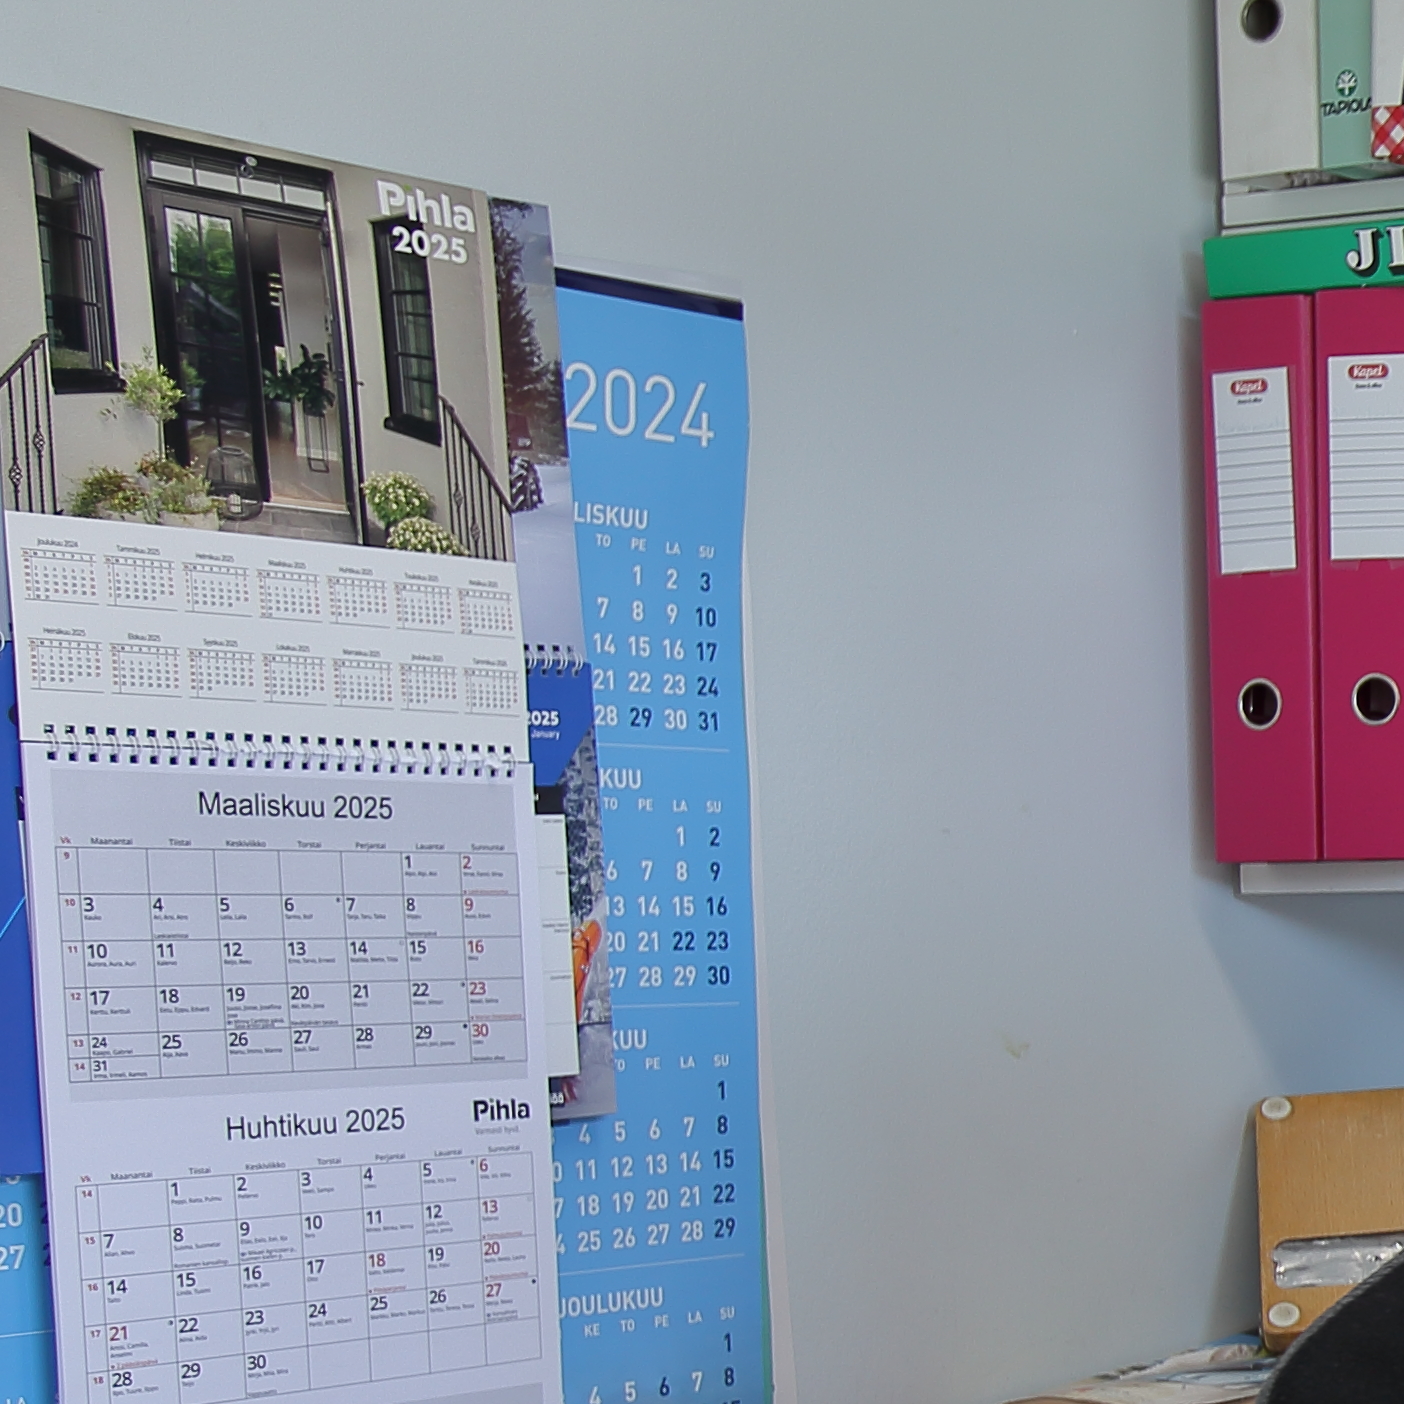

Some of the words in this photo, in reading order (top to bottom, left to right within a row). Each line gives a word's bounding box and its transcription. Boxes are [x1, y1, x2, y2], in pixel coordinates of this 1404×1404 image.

[377, 180, 476, 234] Pihla
[391, 226, 469, 264] 2025
[1352, 364, 1384, 378] Kapel
[565, 361, 715, 448] 2024
[574, 501, 649, 530] LISKUU
[596, 534, 612, 548] TO
[631, 538, 647, 552] PE
[665, 542, 681, 555] LA
[699, 545, 715, 559] SU
[633, 565, 642, 586] 1
[665, 568, 679, 590] 2
[699, 572, 712, 592] 3
[597, 597, 609, 619] 7
[631, 600, 645, 622] 8
[665, 603, 678, 625] 9
[695, 607, 717, 628] 10
[527, 710, 560, 726] 025
[594, 705, 618, 726] 28
[629, 707, 652, 729] 29
[663, 709, 687, 731] 30
[698, 711, 720, 732] 31
[601, 768, 643, 790] KUU
[198, 790, 326, 820] Maaliskuu
[333, 794, 394, 821] 2025
[87, 944, 108, 960] 10
[156, 943, 175, 958] 11
[223, 942, 243, 957] 12
[288, 941, 306, 956] 13
[349, 940, 368, 955] 14
[606, 932, 626, 952] 20
[637, 932, 660, 952] 21
[672, 931, 696, 952] 22
[706, 931, 729, 951] 23
[226, 1115, 338, 1141] Huhtikuu
[345, 1106, 405, 1135] 2025
[472, 1098, 530, 1123] Pihla
[577, 1195, 600, 1217] 18
[612, 1192, 635, 1214] 19
[646, 1189, 670, 1210] 20
[679, 1187, 702, 1207] 21
[713, 1184, 736, 1204] 22
[560, 1286, 664, 1319] JOULUKUU
[111, 1371, 133, 1388] 28
[180, 1362, 201, 1378] 29
[247, 1354, 267, 1370] 30
